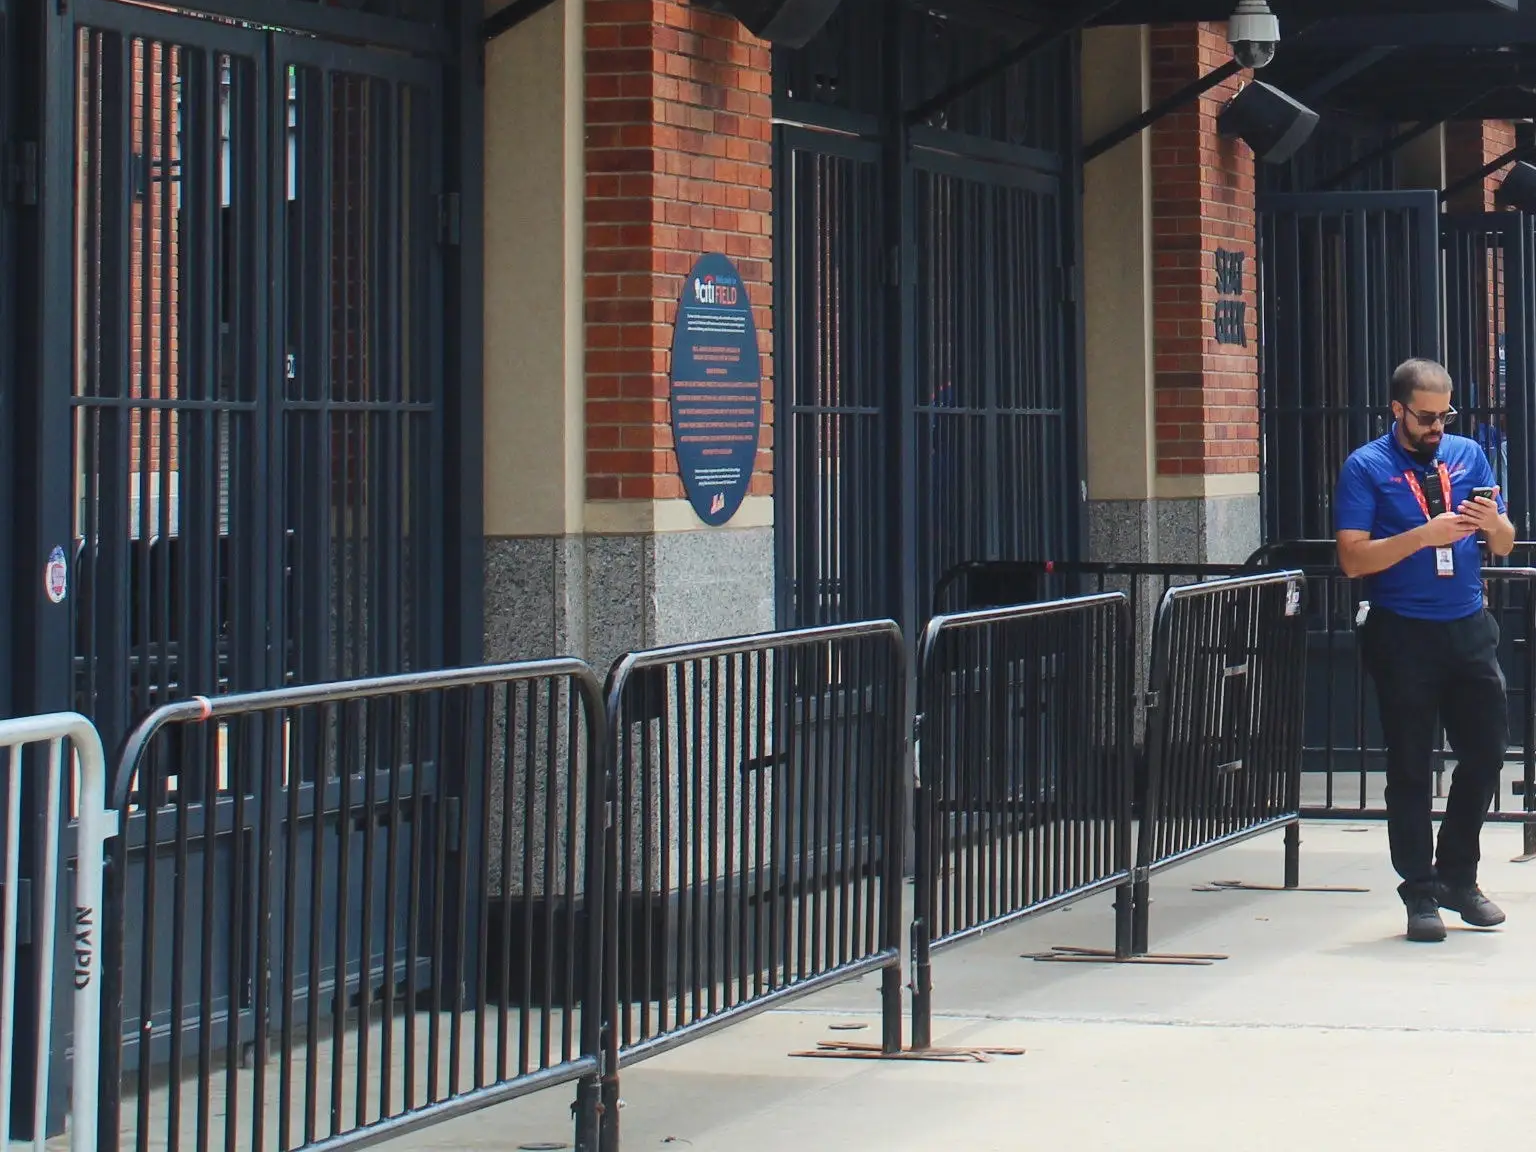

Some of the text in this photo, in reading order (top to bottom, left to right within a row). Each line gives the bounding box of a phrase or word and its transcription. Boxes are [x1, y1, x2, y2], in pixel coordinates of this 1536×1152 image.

[700, 280, 738, 305] citi FIELD
[74, 906, 93, 990] NYPD
